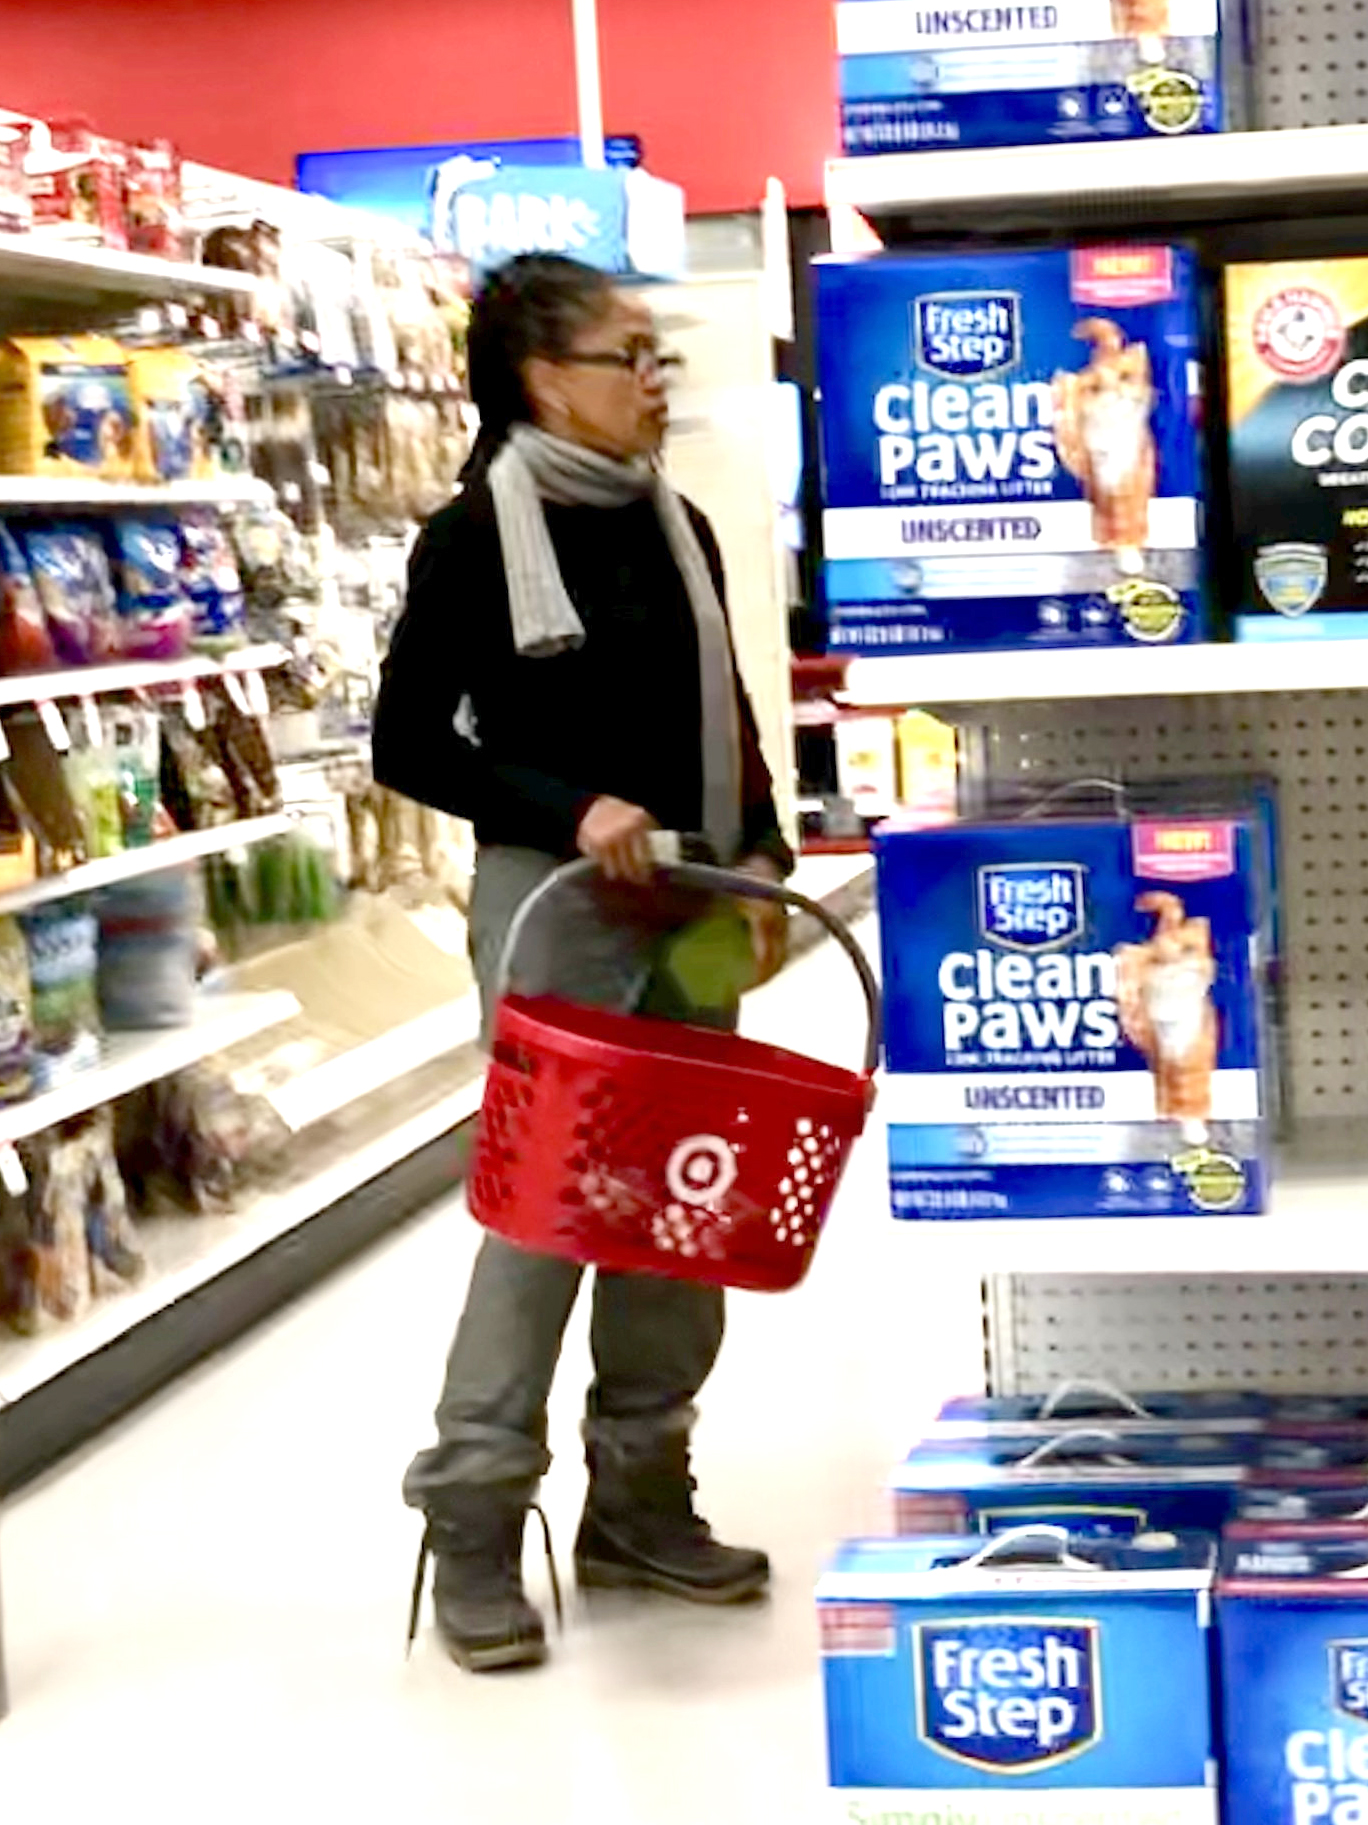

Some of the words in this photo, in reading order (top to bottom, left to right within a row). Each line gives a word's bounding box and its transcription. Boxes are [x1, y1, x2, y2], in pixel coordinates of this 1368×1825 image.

[926, 302, 1009, 333] Fresh
[930, 334, 1005, 366] Step
[902, 516, 1042, 544] UNSCENTED
[989, 874, 1072, 905] Fresh
[993, 904, 1068, 936] Step
[964, 1085, 1105, 1110] UNSCENTED
[932, 1637, 1079, 1688] Fresh
[940, 1690, 1075, 1746] Step
